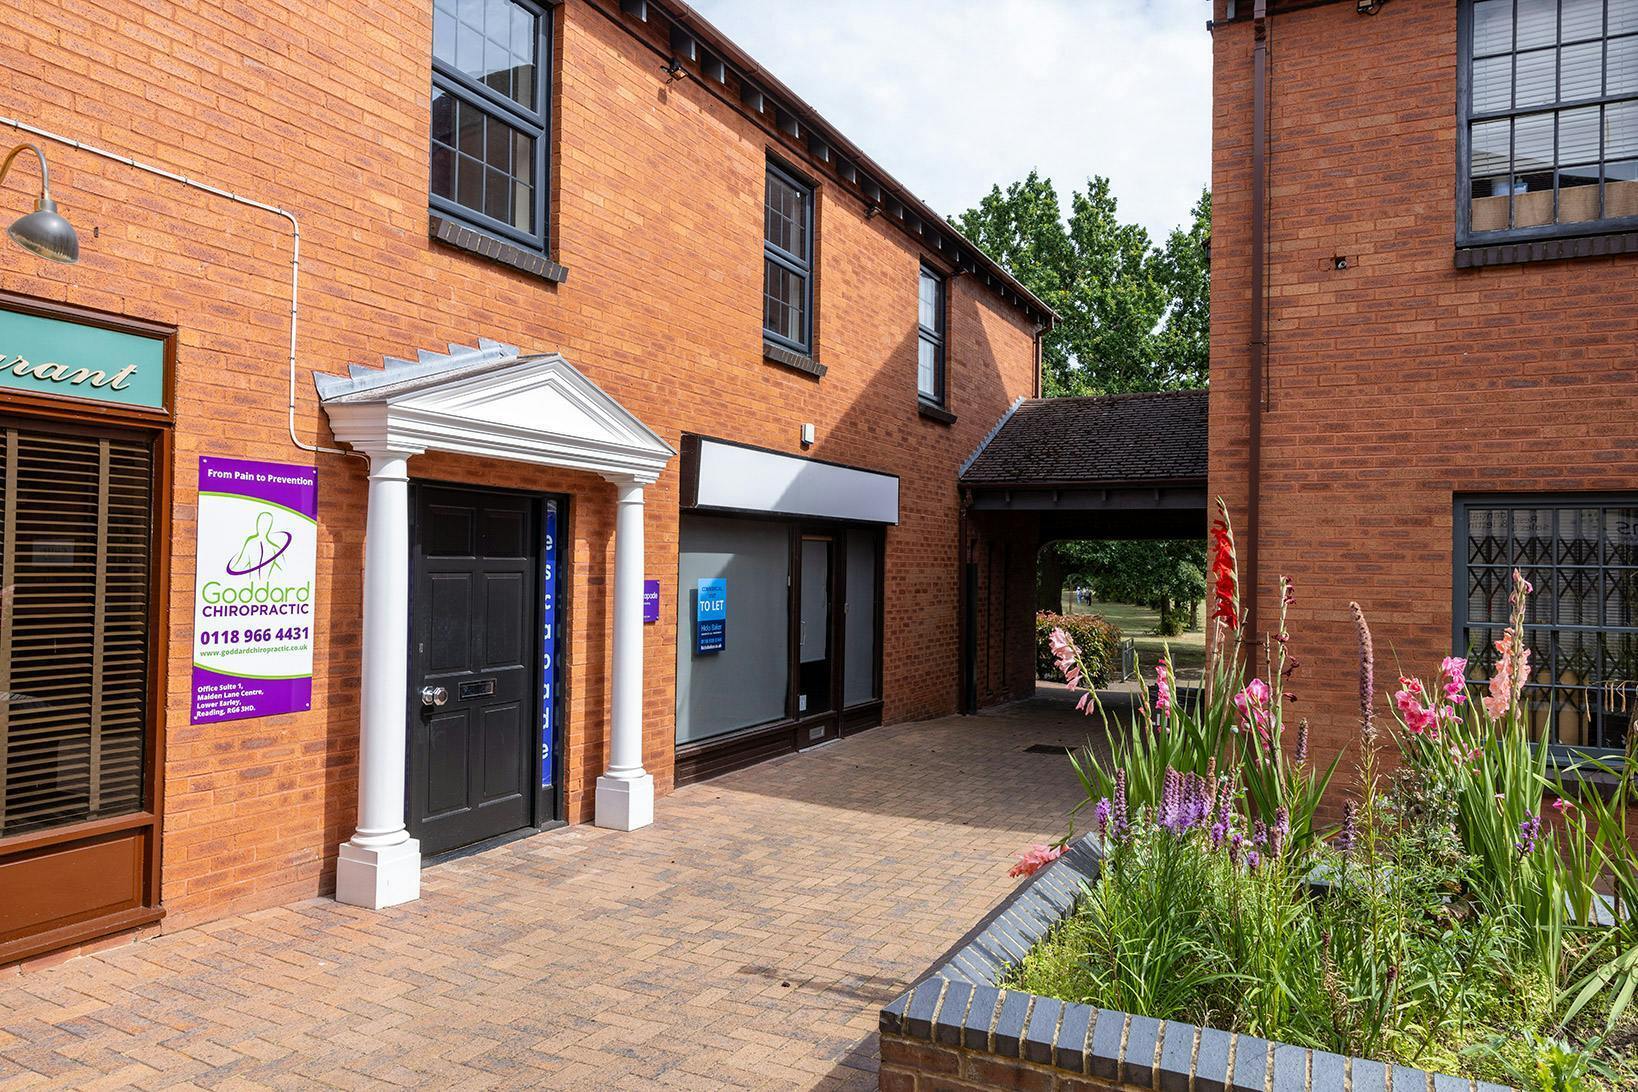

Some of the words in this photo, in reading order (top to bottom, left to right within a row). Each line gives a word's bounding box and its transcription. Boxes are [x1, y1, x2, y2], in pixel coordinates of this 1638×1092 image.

[207, 468, 232, 479] From
[234, 471, 255, 481] Pain
[256, 473, 266, 482] to
[267, 474, 313, 486] Prevention
[202, 581, 310, 604] Goddard
[643, 591, 658, 601] apade
[202, 603, 309, 618] CHIROPRACTIC
[699, 600, 710, 612] TO
[711, 599, 724, 611] LET
[200, 630, 240, 645] 0118
[244, 628, 272, 643] 966
[275, 626, 309, 641] 4431
[200, 644, 308, 657] www.goddardchiropractic.co.uk
[197, 685, 218, 693] Office
[219, 683, 237, 691] Suite
[197, 692, 223, 701] Maiden
[223, 691, 240, 699] Lane
[196, 701, 218, 709] Lower
